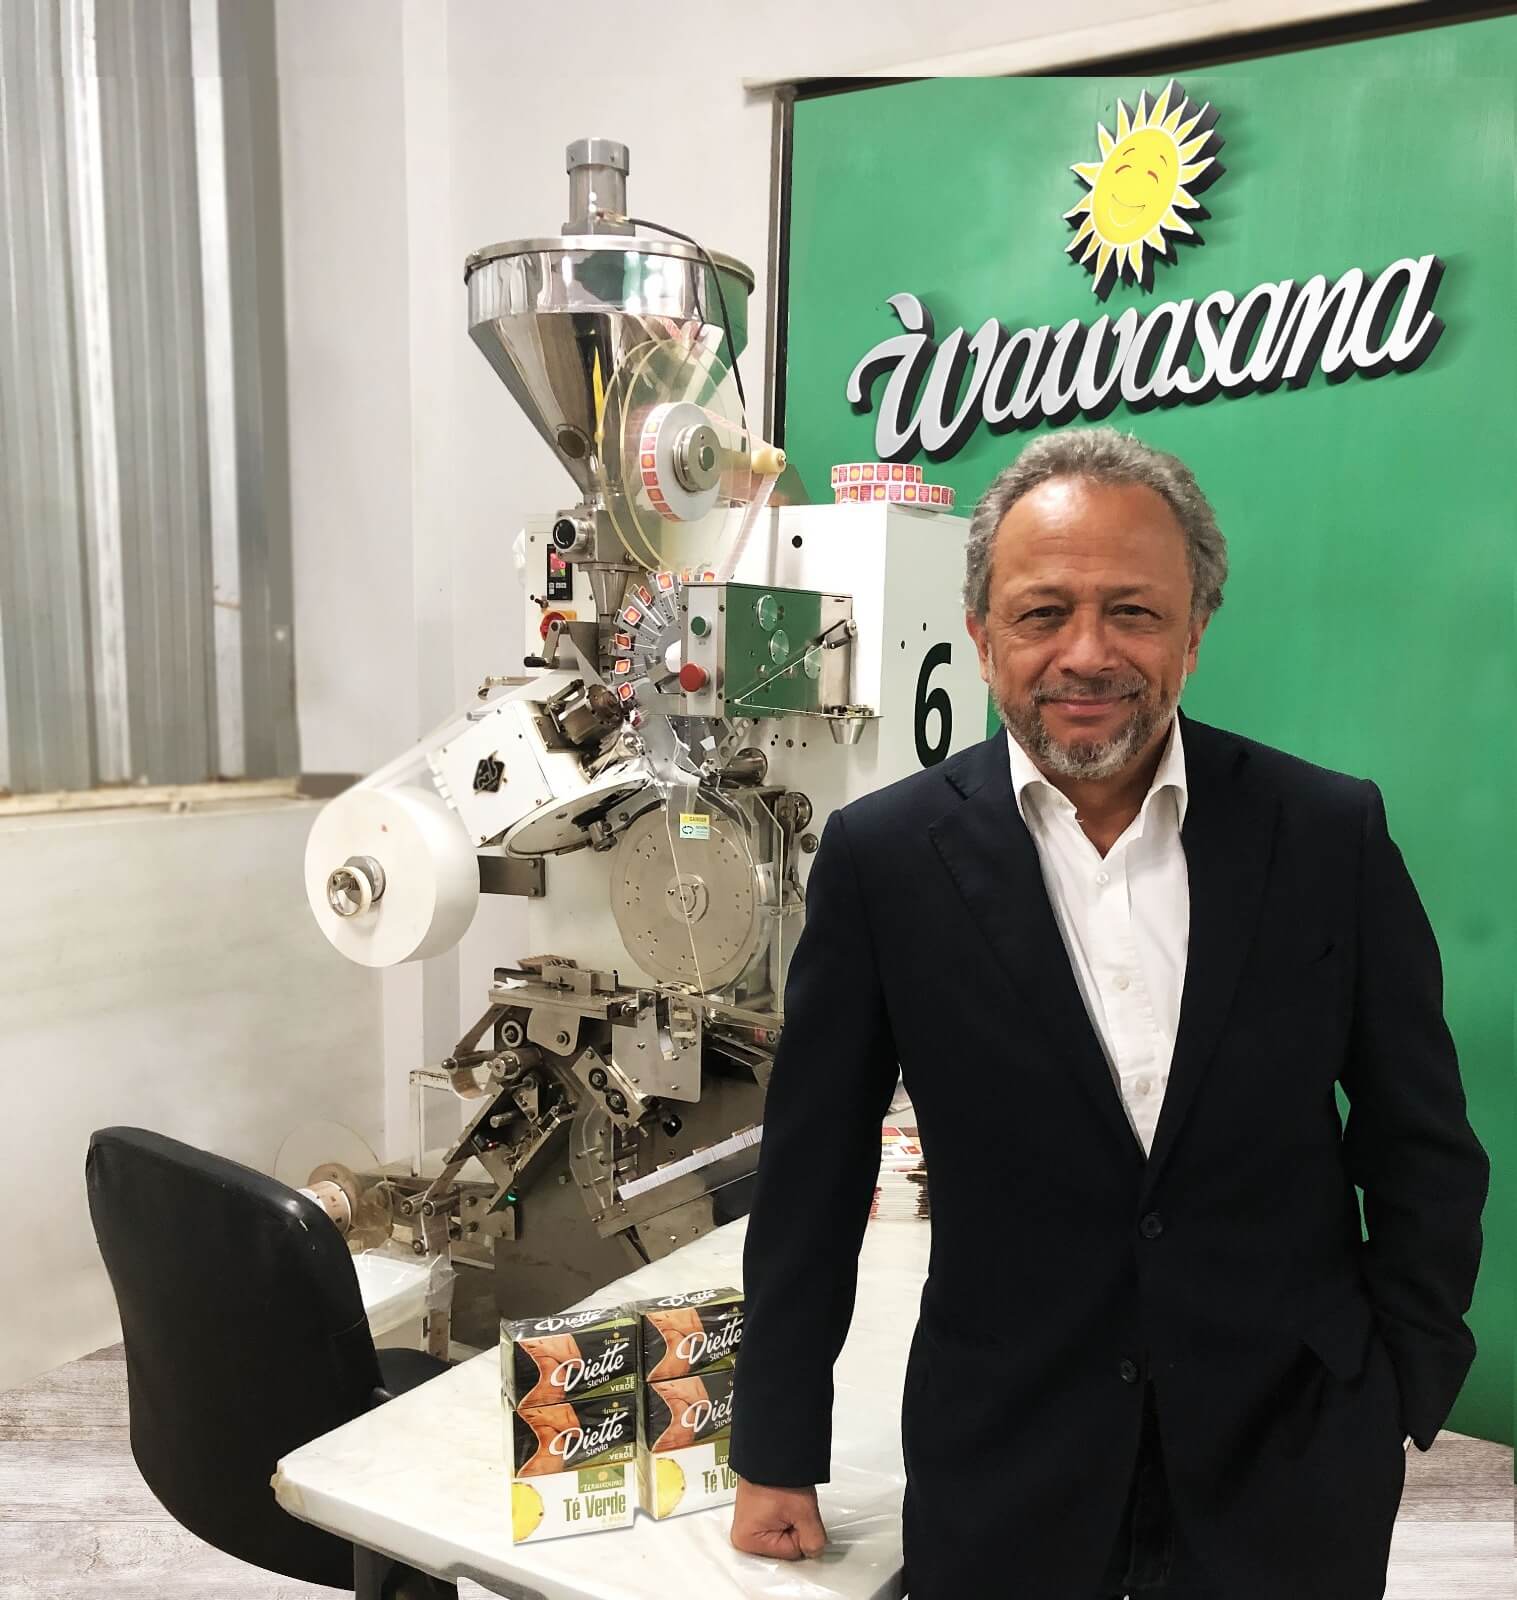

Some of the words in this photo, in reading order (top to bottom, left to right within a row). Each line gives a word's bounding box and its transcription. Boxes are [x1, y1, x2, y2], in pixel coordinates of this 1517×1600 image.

[914, 642, 953, 769] 6
[534, 1309, 602, 1331] Diette
[675, 1317, 743, 1365] Diette
[550, 1342, 629, 1391] Diette
[586, 1374, 610, 1388] Stevia
[610, 1382, 635, 1391] VERDE
[681, 1389, 734, 1432] Diet
[548, 1412, 628, 1460] Diette
[586, 1443, 609, 1457] Stevia
[702, 1469, 718, 1494] Té
[563, 1497, 581, 1522] Té
[585, 1491, 626, 1519] Verde
